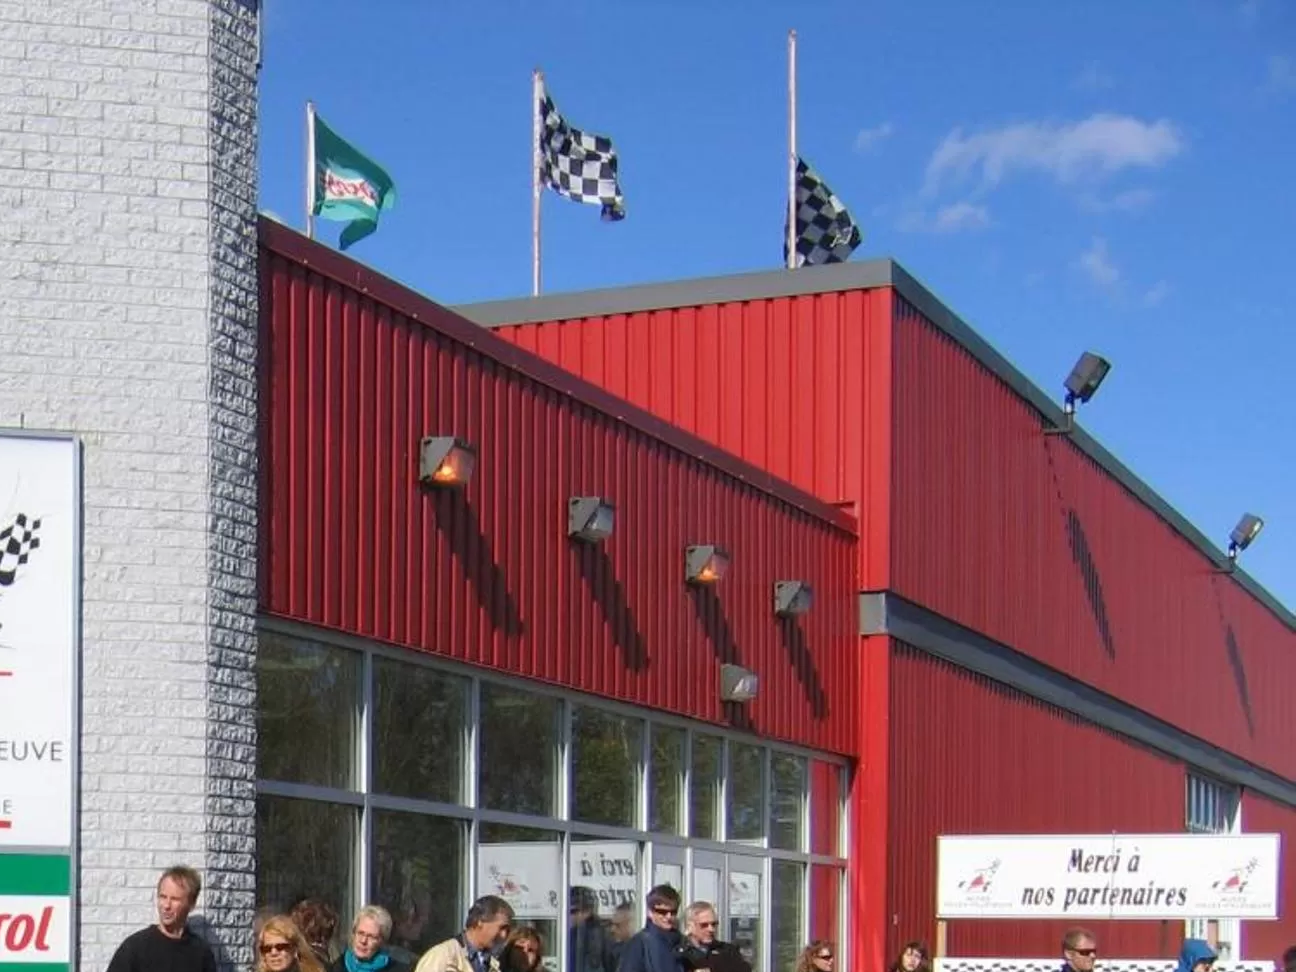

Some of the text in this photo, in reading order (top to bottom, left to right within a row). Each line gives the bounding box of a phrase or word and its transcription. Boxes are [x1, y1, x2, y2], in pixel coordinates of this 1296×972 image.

[1067, 846, 1140, 873] Merci à
[1021, 880, 1187, 912] nos partenaires
